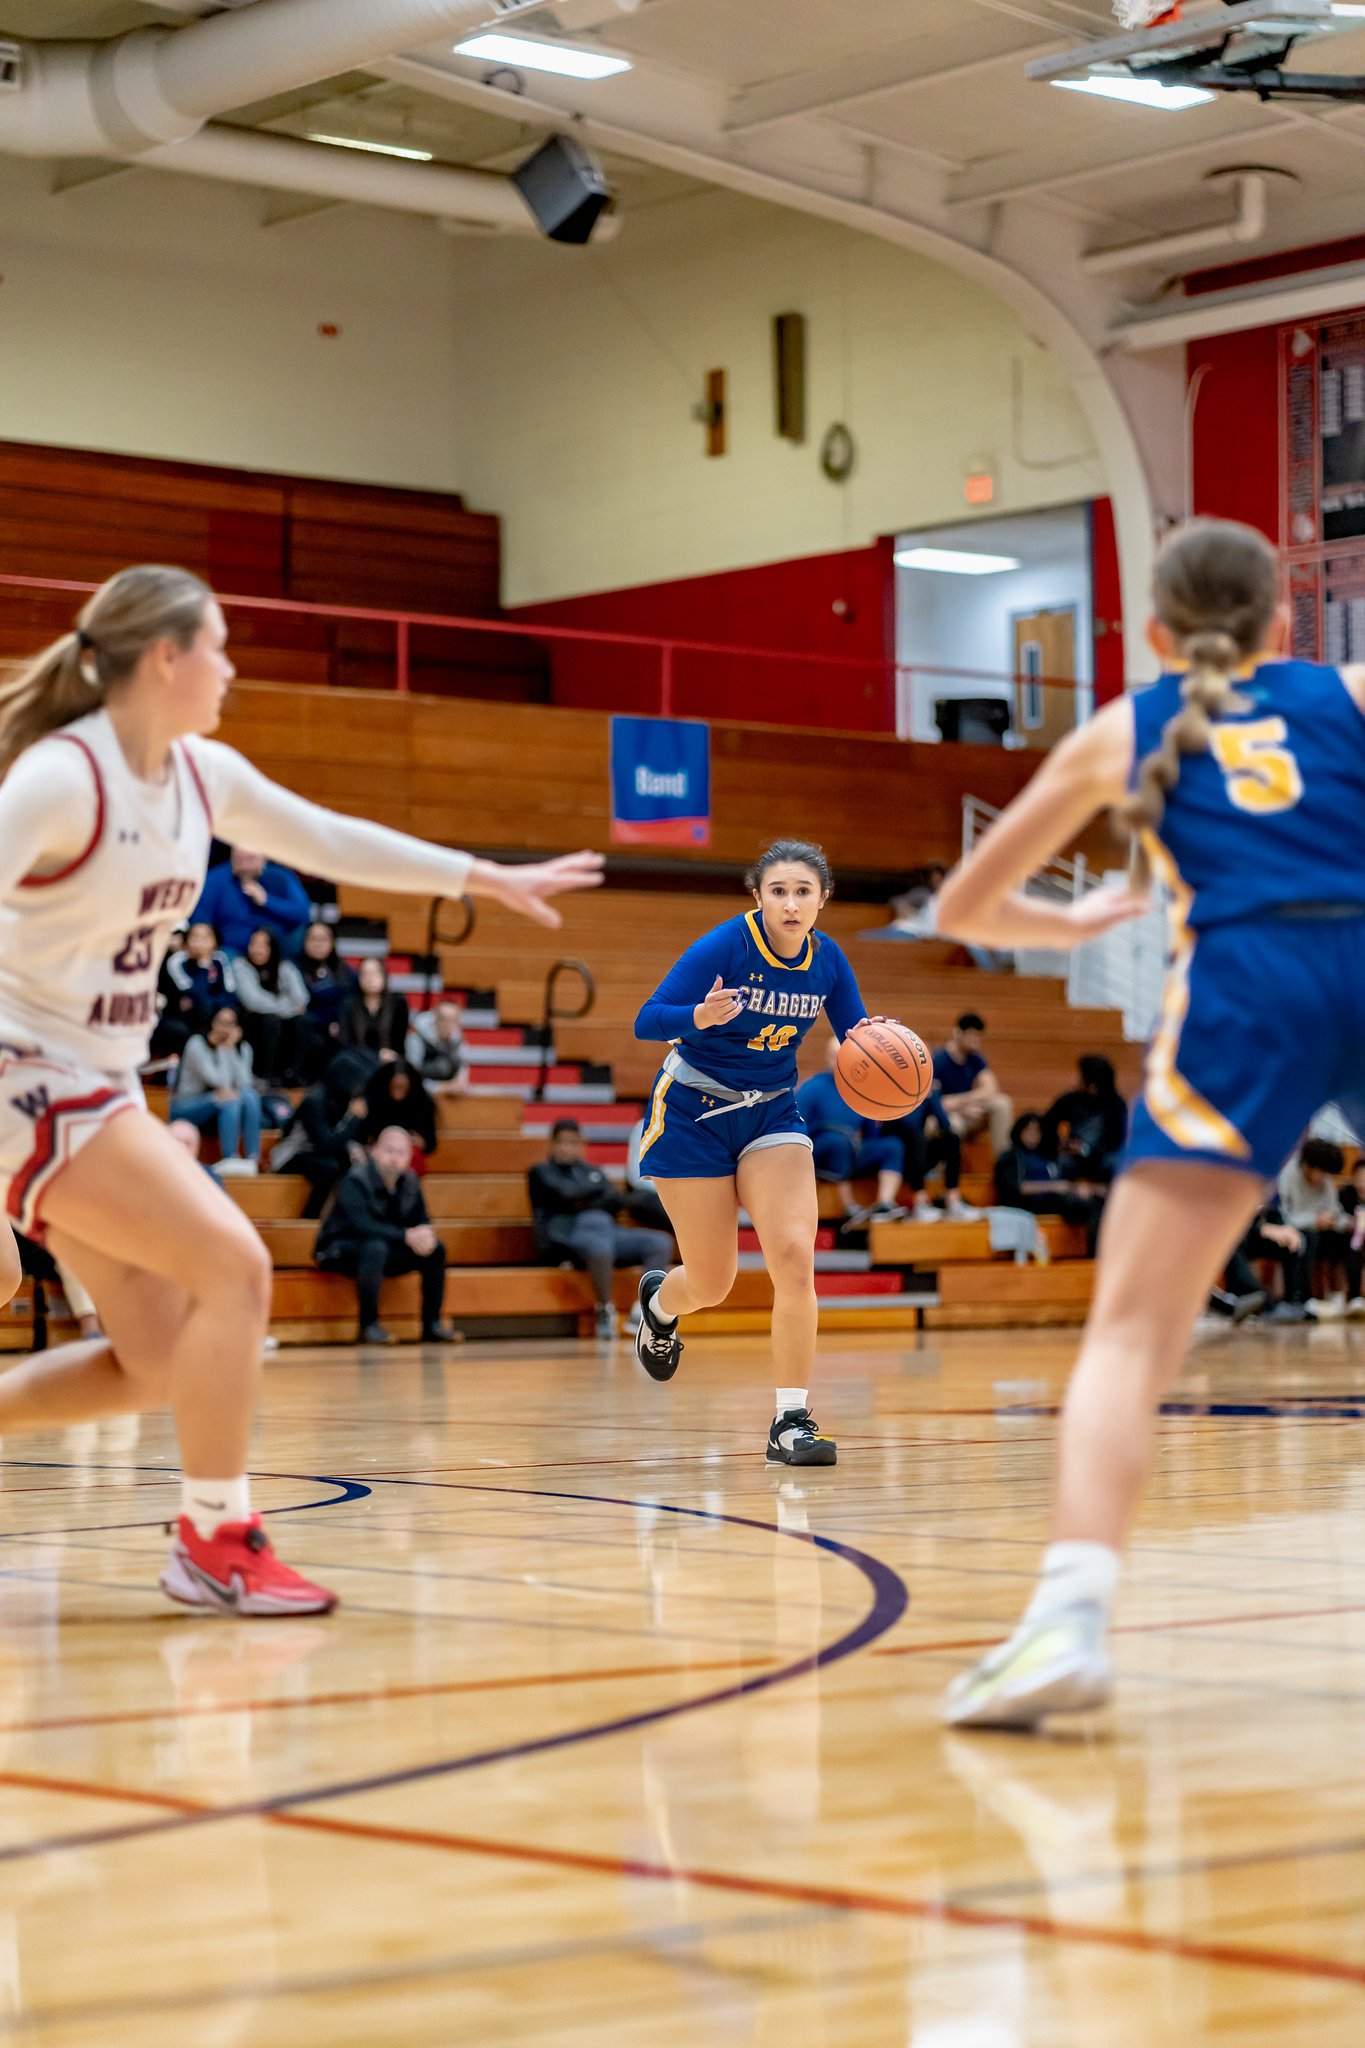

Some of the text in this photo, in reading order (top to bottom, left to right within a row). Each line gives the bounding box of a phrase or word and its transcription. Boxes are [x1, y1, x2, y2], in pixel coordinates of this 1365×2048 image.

[635, 766, 687, 797] Band
[1209, 714, 1305, 816] 5
[747, 1024, 798, 1052] 10
[864, 1028, 909, 1071] EVOLUTION
